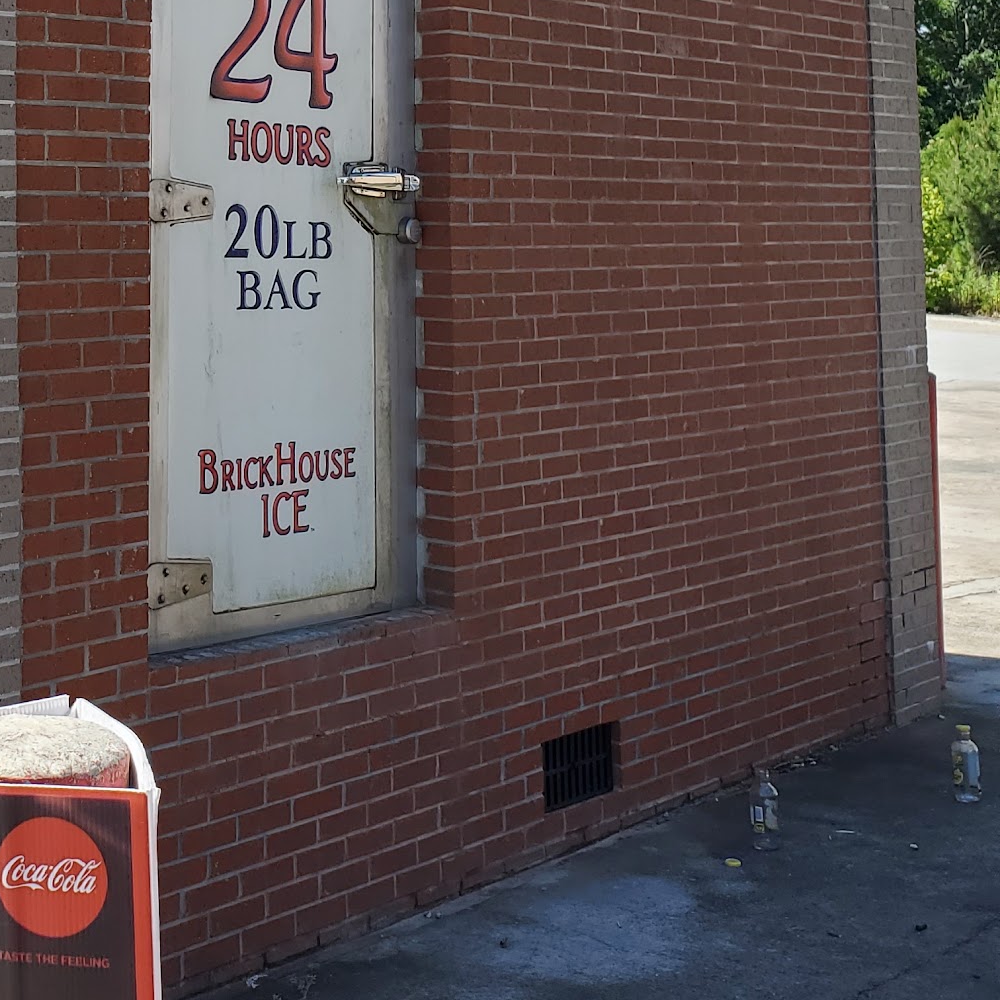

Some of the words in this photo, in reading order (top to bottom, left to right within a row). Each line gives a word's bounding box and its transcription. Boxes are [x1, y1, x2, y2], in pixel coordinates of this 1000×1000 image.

[227, 119, 331, 167] HOURS
[224, 203, 332, 260] 20LB
[236, 269, 321, 310] BAG
[197, 441, 356, 494] BRICKHOUSE
[261, 489, 309, 538] ICE
[1, 855, 102, 893] Coca-Cola
[35, 953, 59, 965] THE
[61, 955, 110, 968] FEELING
